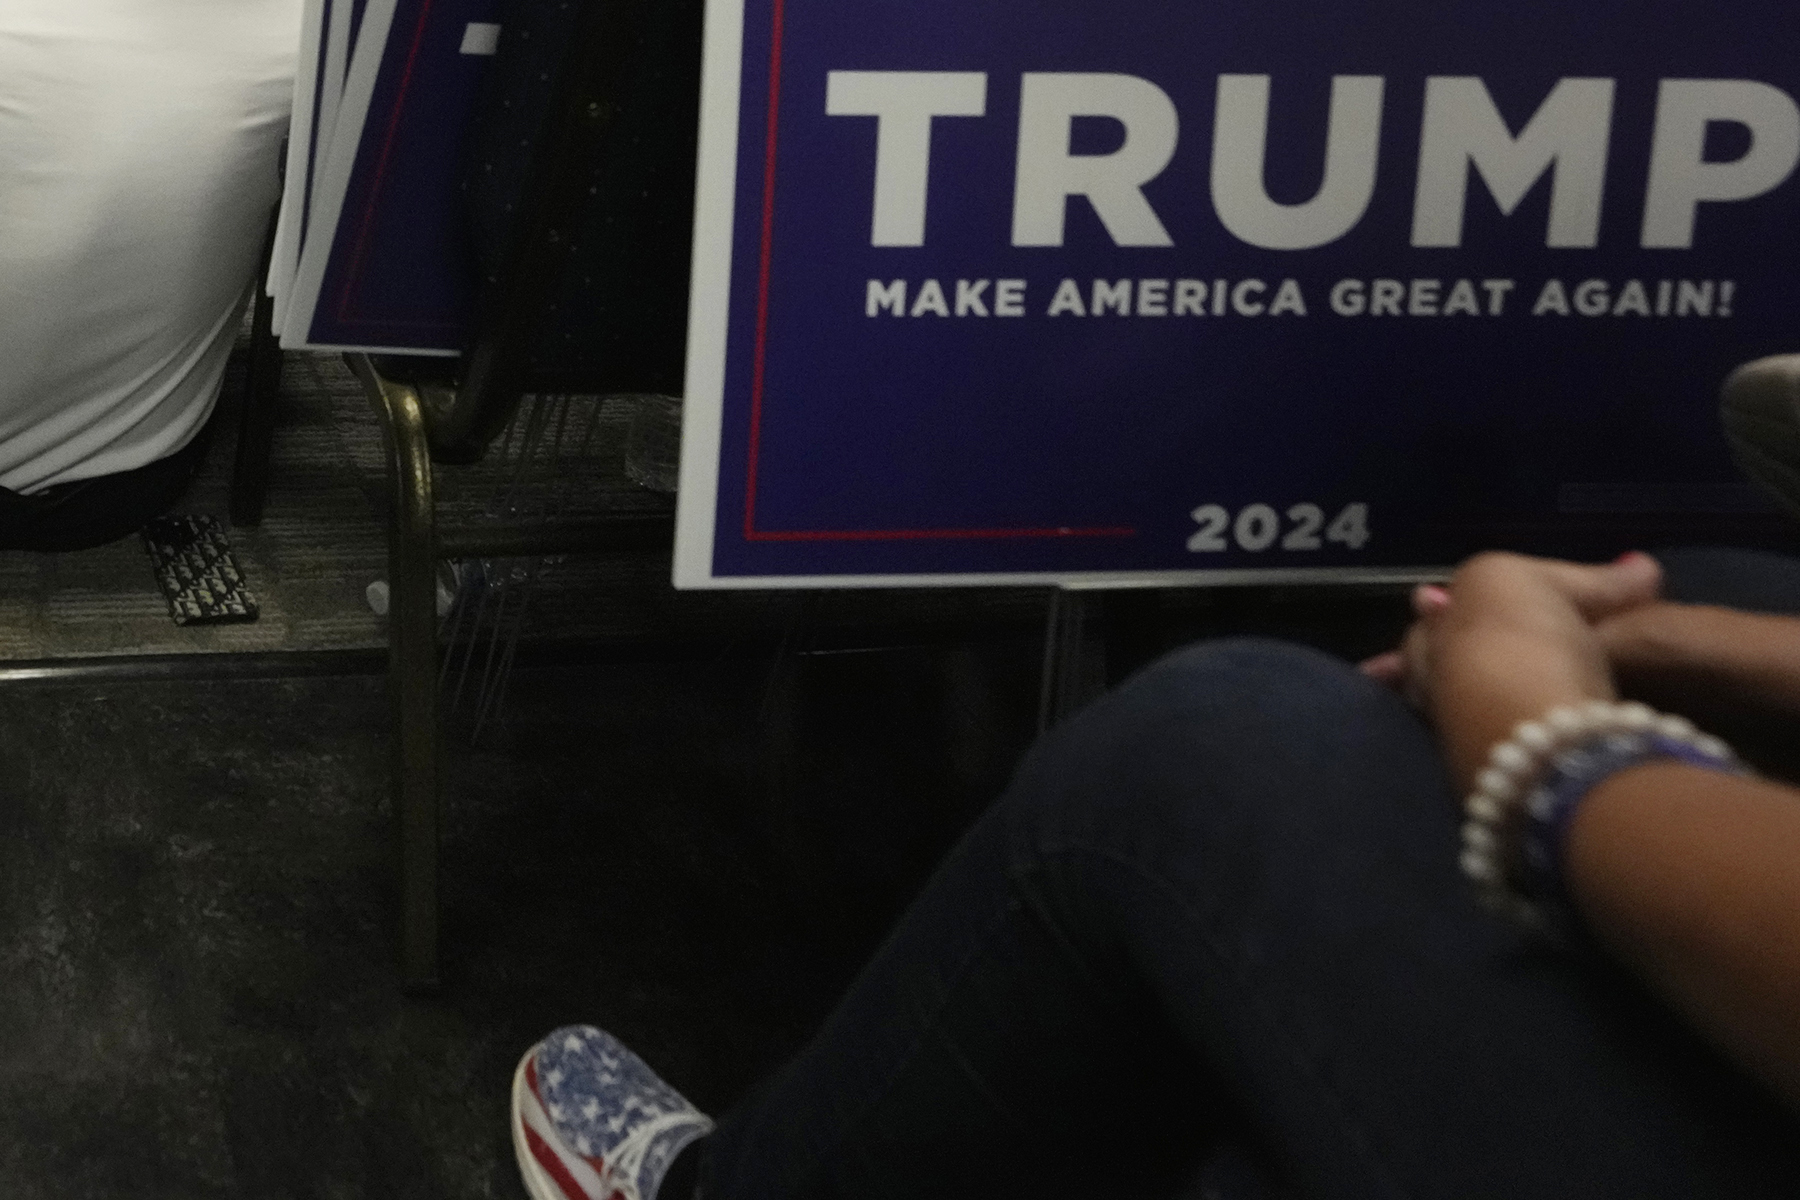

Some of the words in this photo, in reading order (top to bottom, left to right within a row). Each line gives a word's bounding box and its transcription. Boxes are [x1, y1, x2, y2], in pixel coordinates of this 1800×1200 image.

[824, 70, 1800, 251] TRUMP
[864, 279, 1028, 318] MAKE
[1048, 279, 1307, 318] AMERICA
[1330, 279, 1515, 317] GREAT
[1532, 279, 1737, 317] AGAIN!
[1186, 503, 1371, 552] 2024
